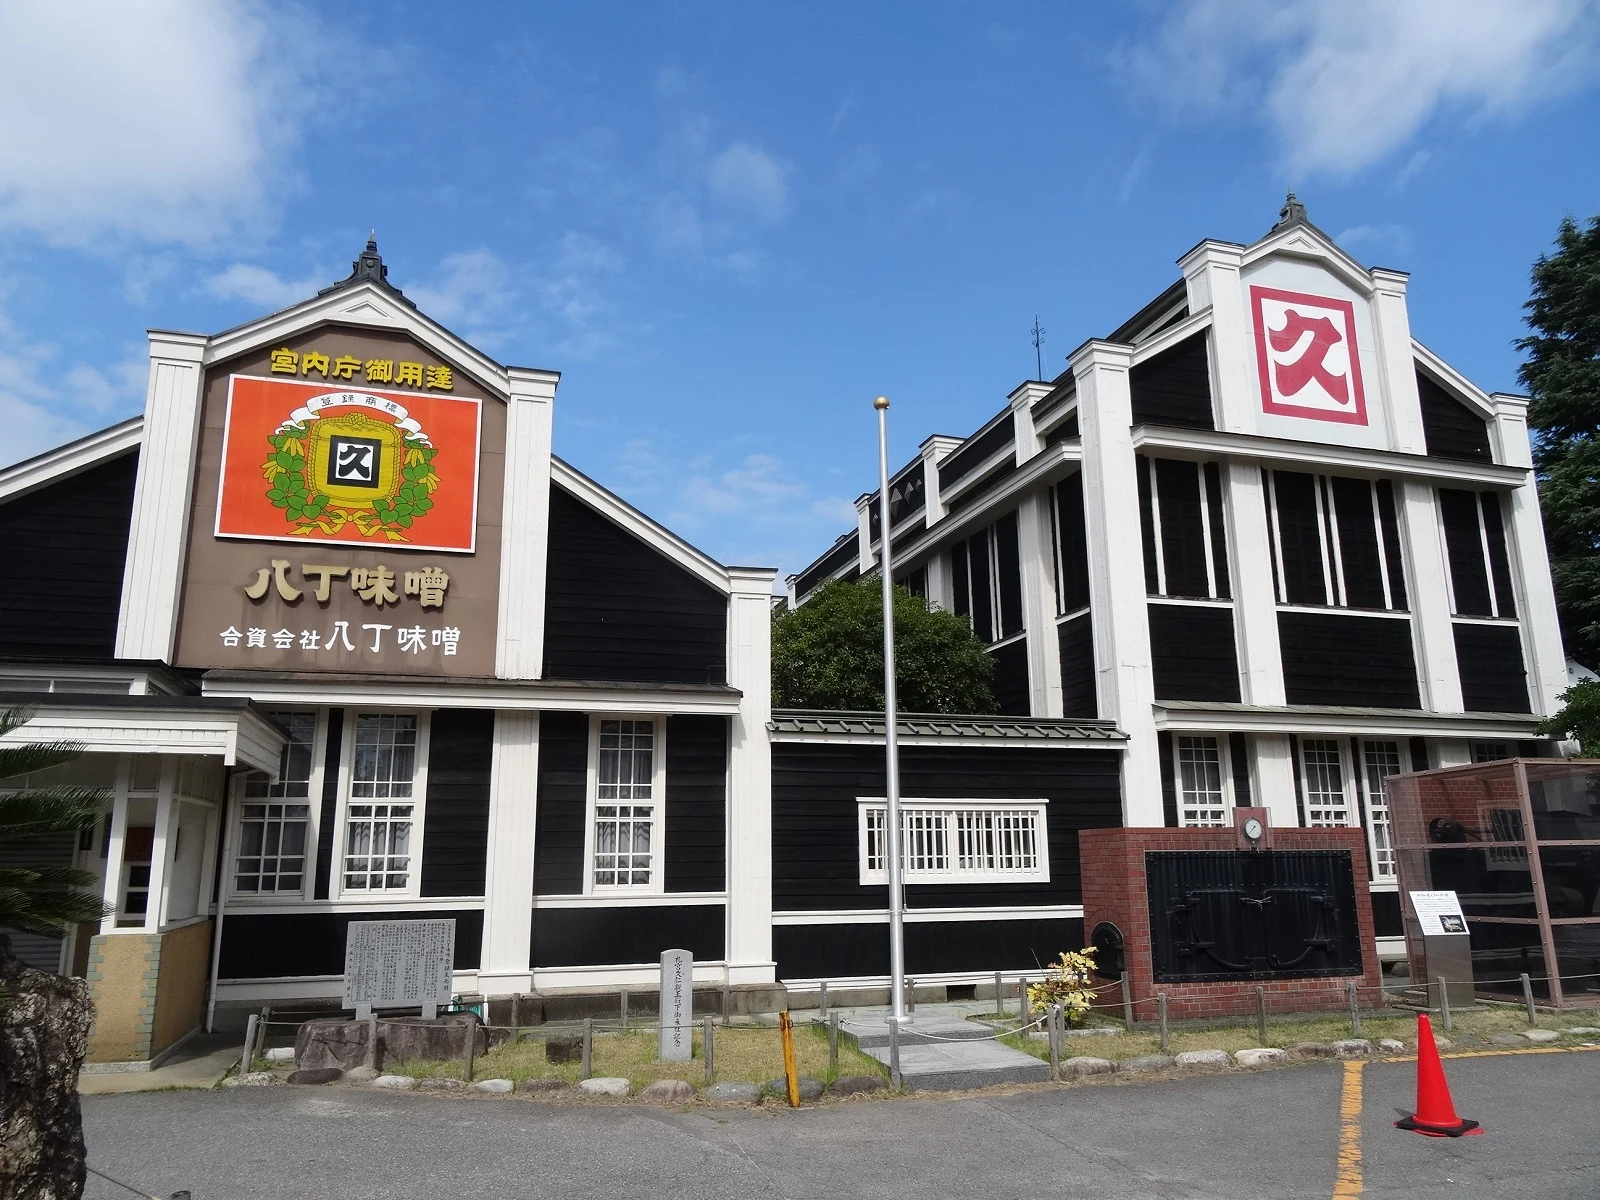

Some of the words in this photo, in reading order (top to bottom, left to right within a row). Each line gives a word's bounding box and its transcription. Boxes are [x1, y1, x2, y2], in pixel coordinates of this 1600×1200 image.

[270, 347, 454, 390] 宮内庁御用達
[244, 559, 450, 608] 八丁味噌
[219, 621, 461, 656] 合資会社八丁味噌
